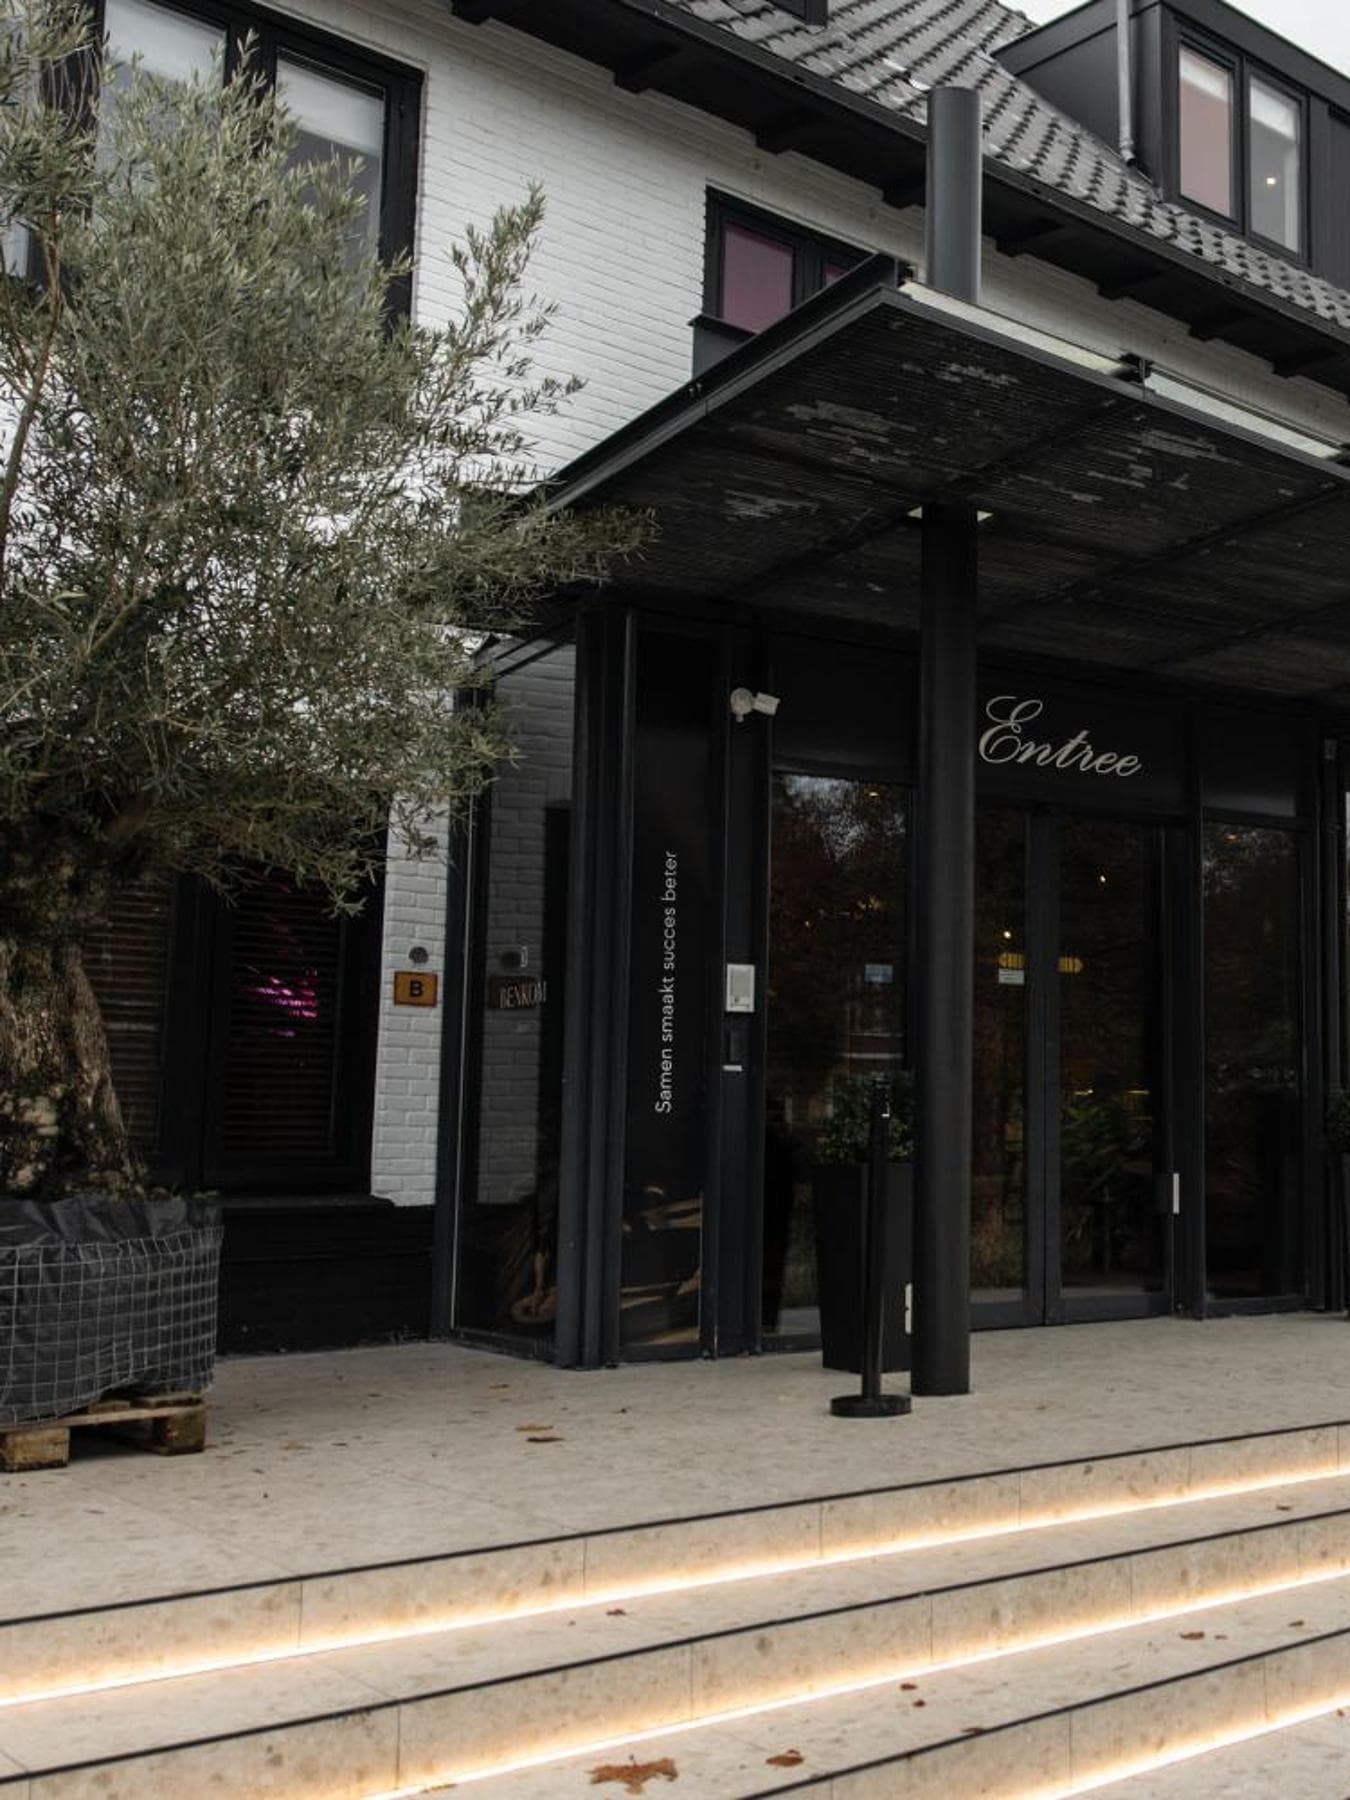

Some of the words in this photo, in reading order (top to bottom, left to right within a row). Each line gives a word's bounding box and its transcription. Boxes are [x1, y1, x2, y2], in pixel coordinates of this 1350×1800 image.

[978, 695, 1143, 777] Entree
[660, 850, 678, 901] beter
[663, 906, 676, 970] succes
[409, 980, 424, 998] B
[657, 976, 675, 1043] smaakt
[654, 1048, 673, 1114] Samen
